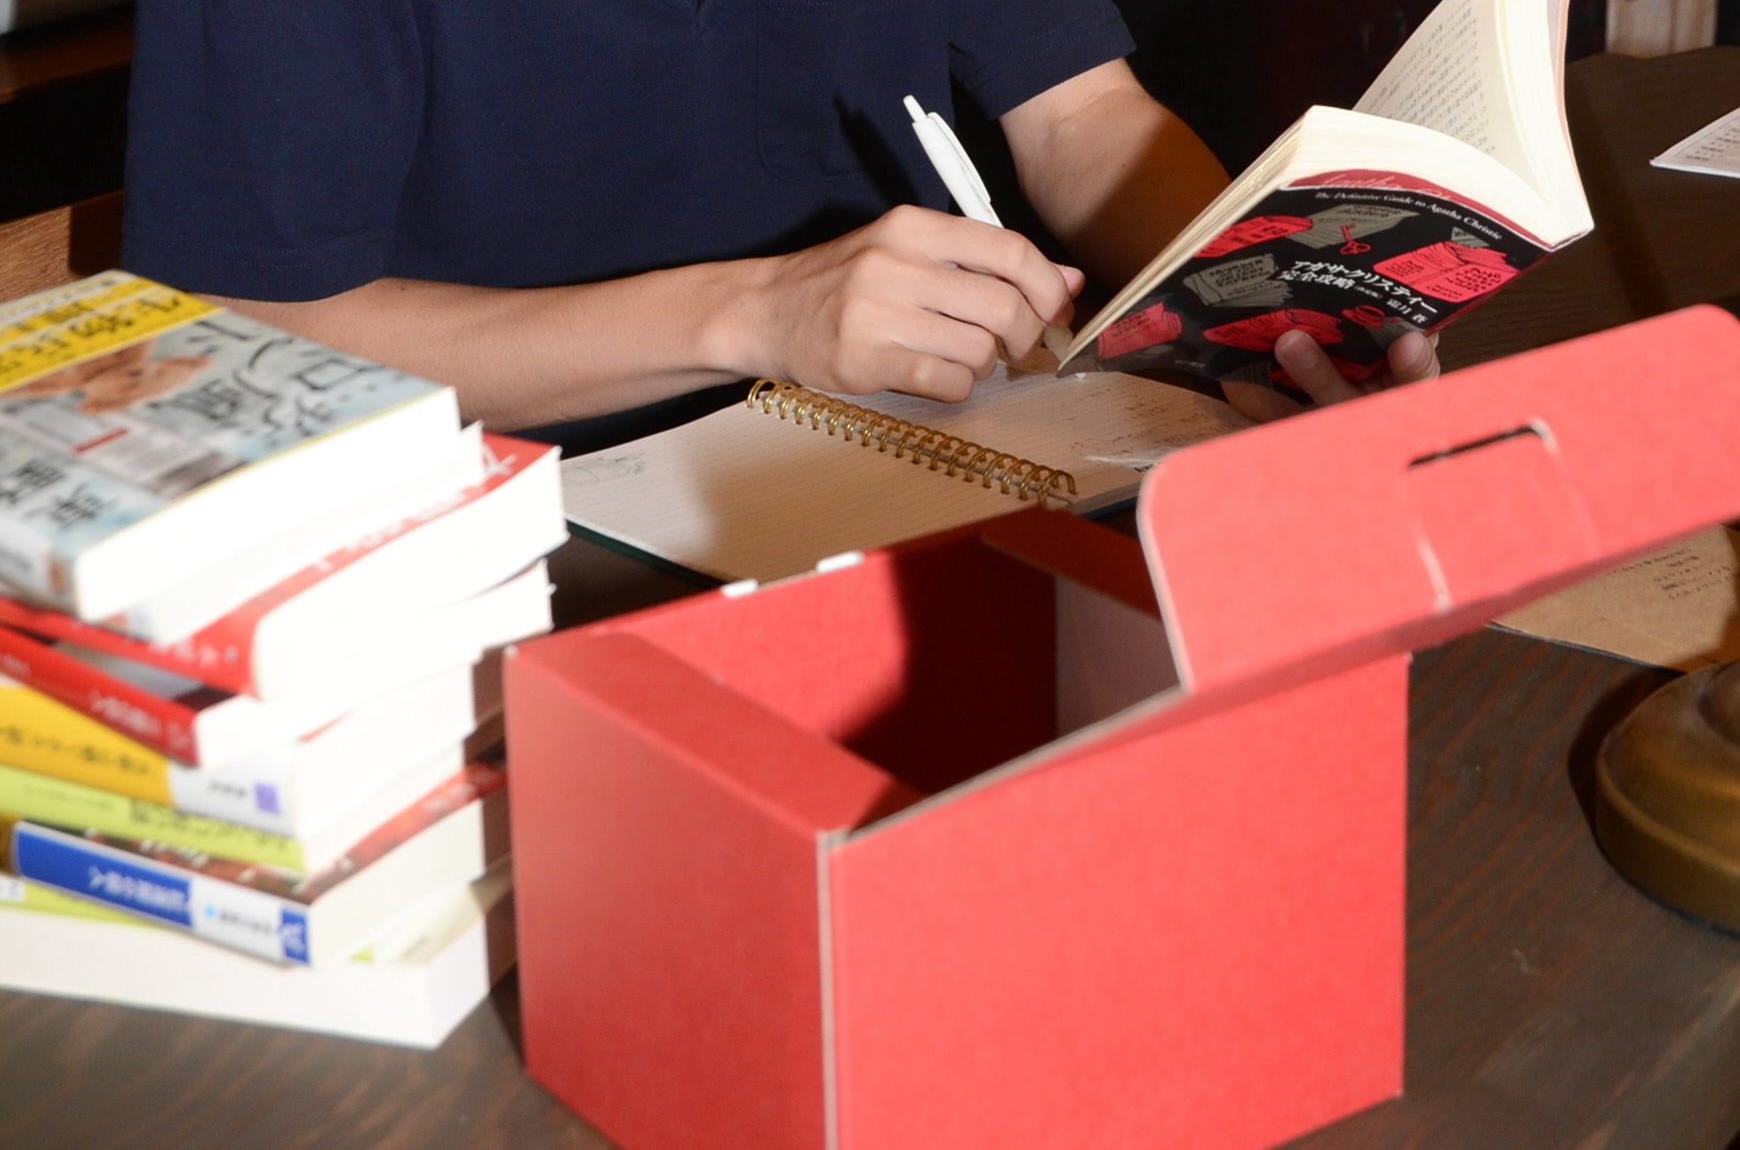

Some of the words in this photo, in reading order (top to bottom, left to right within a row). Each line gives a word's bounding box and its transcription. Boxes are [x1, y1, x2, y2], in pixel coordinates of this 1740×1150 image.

[1383, 193, 1414, 204] Guide
[1426, 202, 1463, 221] Agatha
[1461, 214, 1504, 241] Christie
[1293, 260, 1438, 314] アガサ・クリスティー
